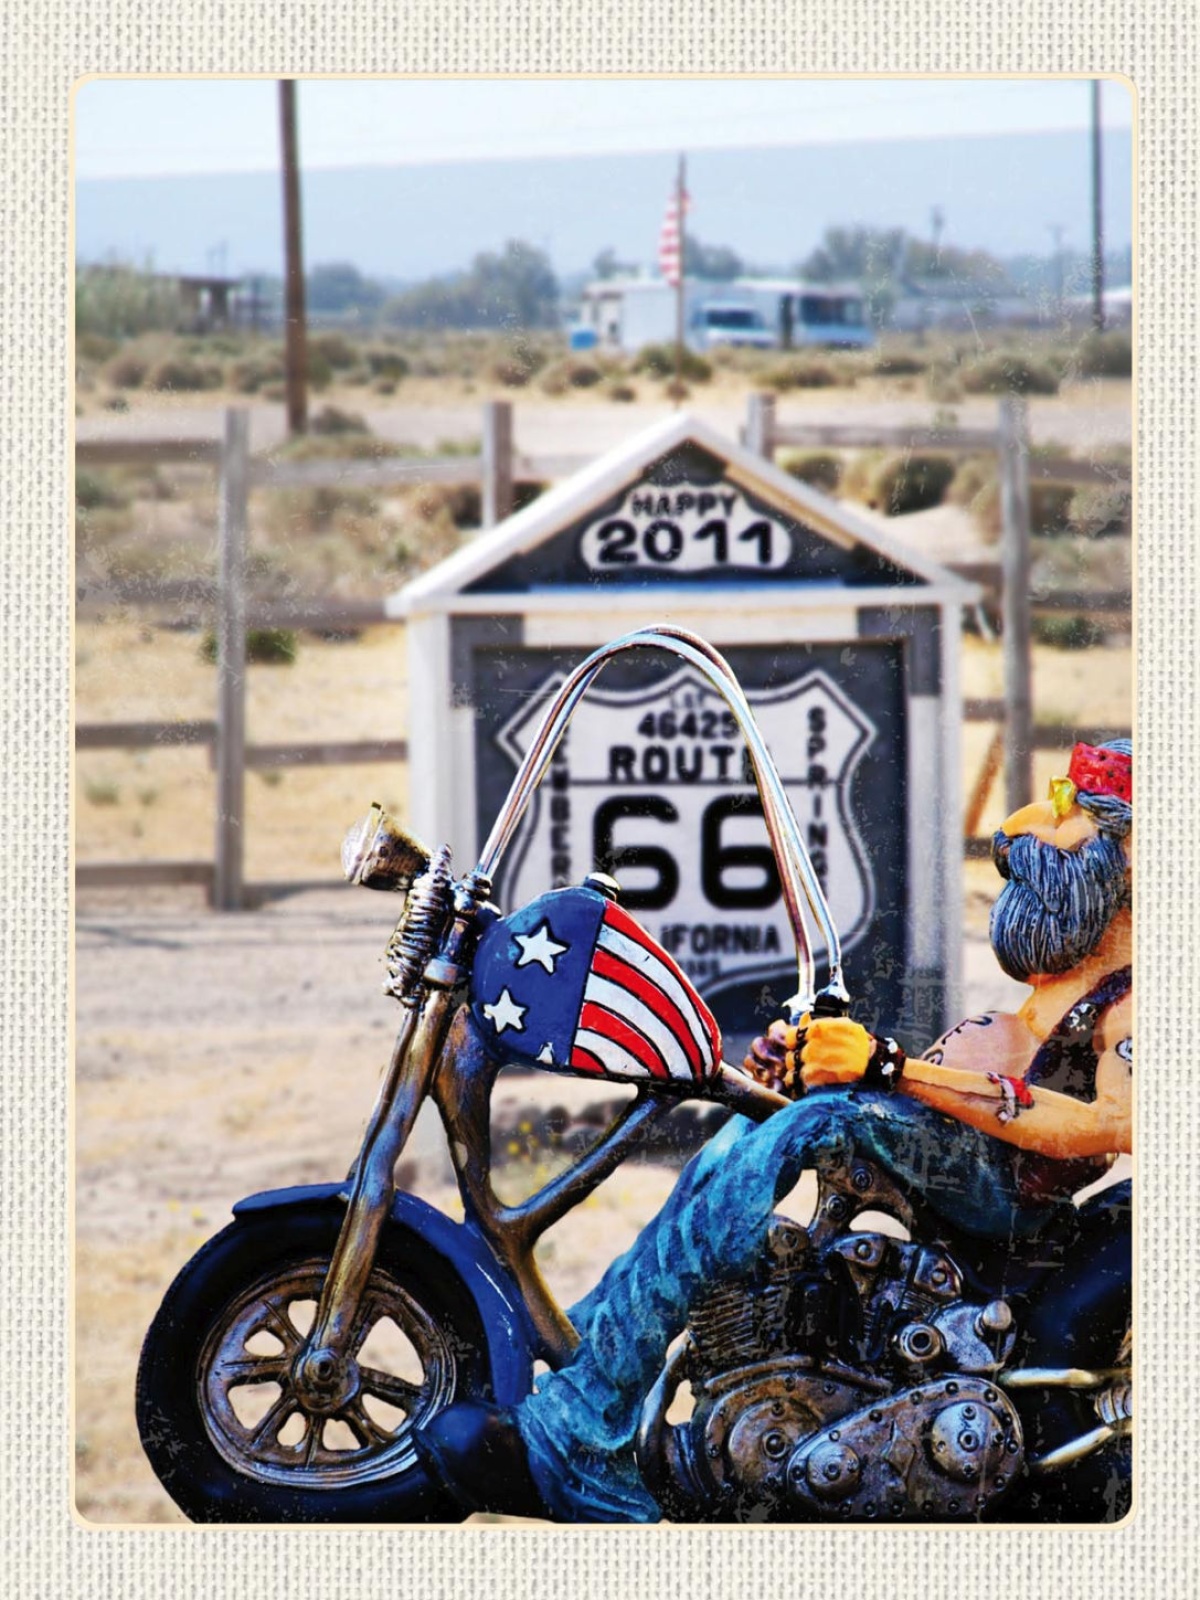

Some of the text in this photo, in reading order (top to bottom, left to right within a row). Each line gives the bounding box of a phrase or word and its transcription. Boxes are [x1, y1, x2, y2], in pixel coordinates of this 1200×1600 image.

[632, 491, 736, 517] HAPPY
[597, 519, 772, 563] 2011
[637, 711, 740, 740] 46425
[593, 795, 783, 911] 66
[660, 924, 780, 954] IFORNIA
